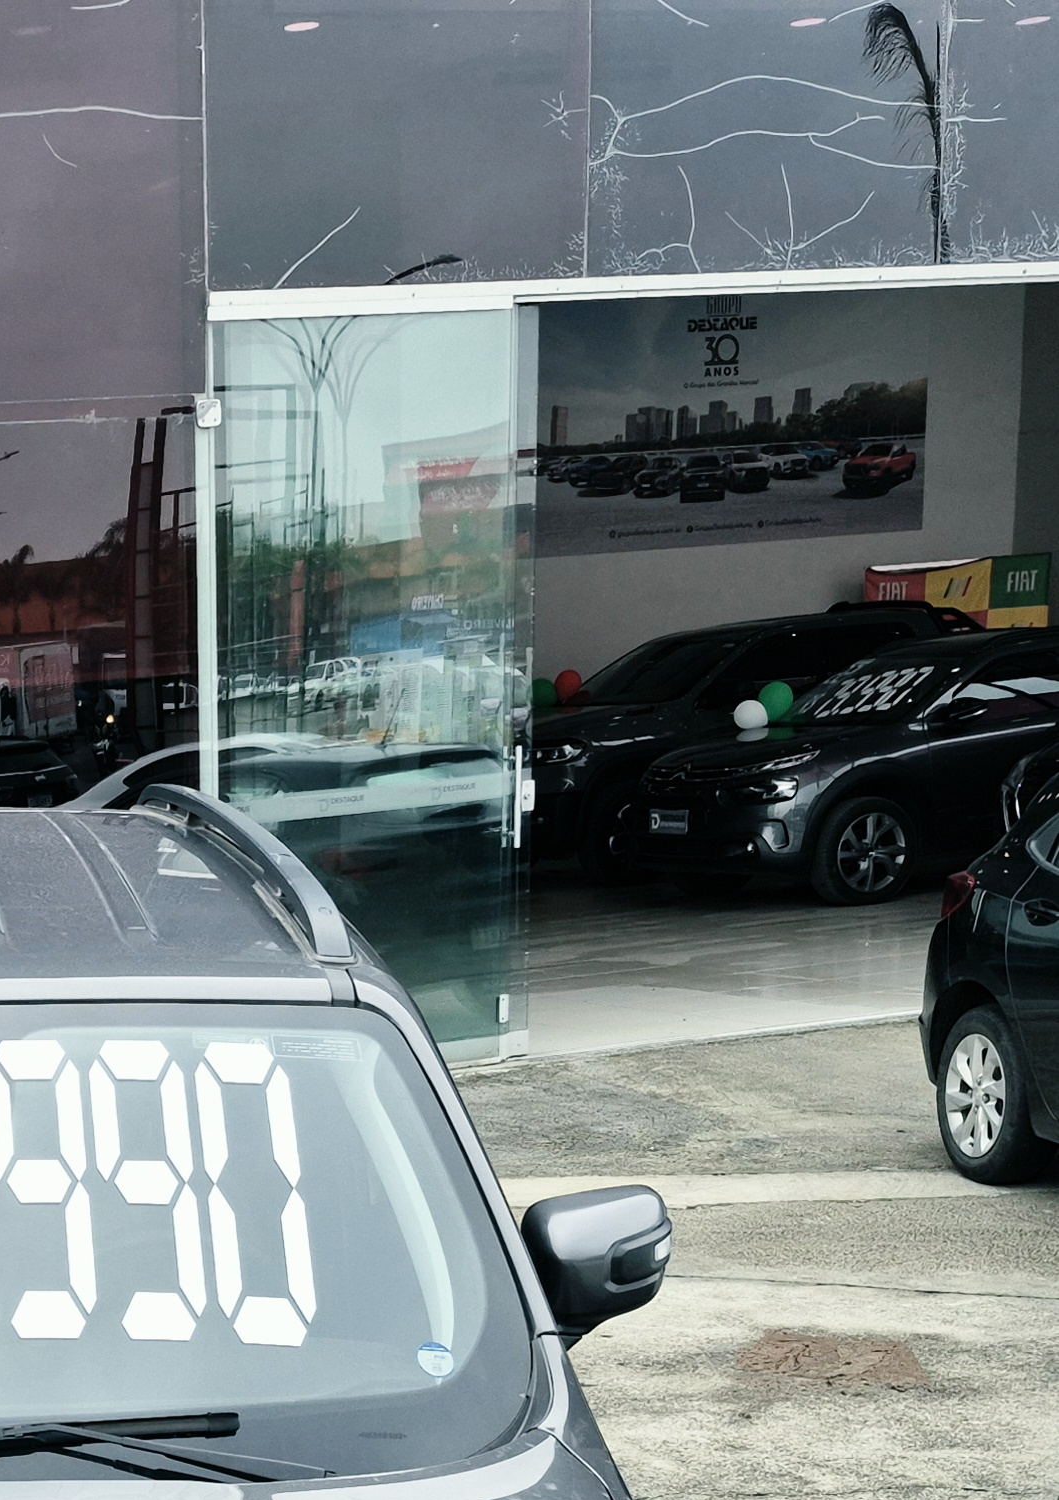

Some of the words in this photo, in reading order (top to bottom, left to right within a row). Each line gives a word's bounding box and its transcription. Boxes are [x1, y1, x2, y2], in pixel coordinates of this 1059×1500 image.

[687, 316, 758, 333] DESTAQUE
[704, 334, 740, 366] 30
[704, 366, 739, 378] ANOS
[878, 581, 909, 601] FIAT
[1006, 570, 1039, 593] FIAT
